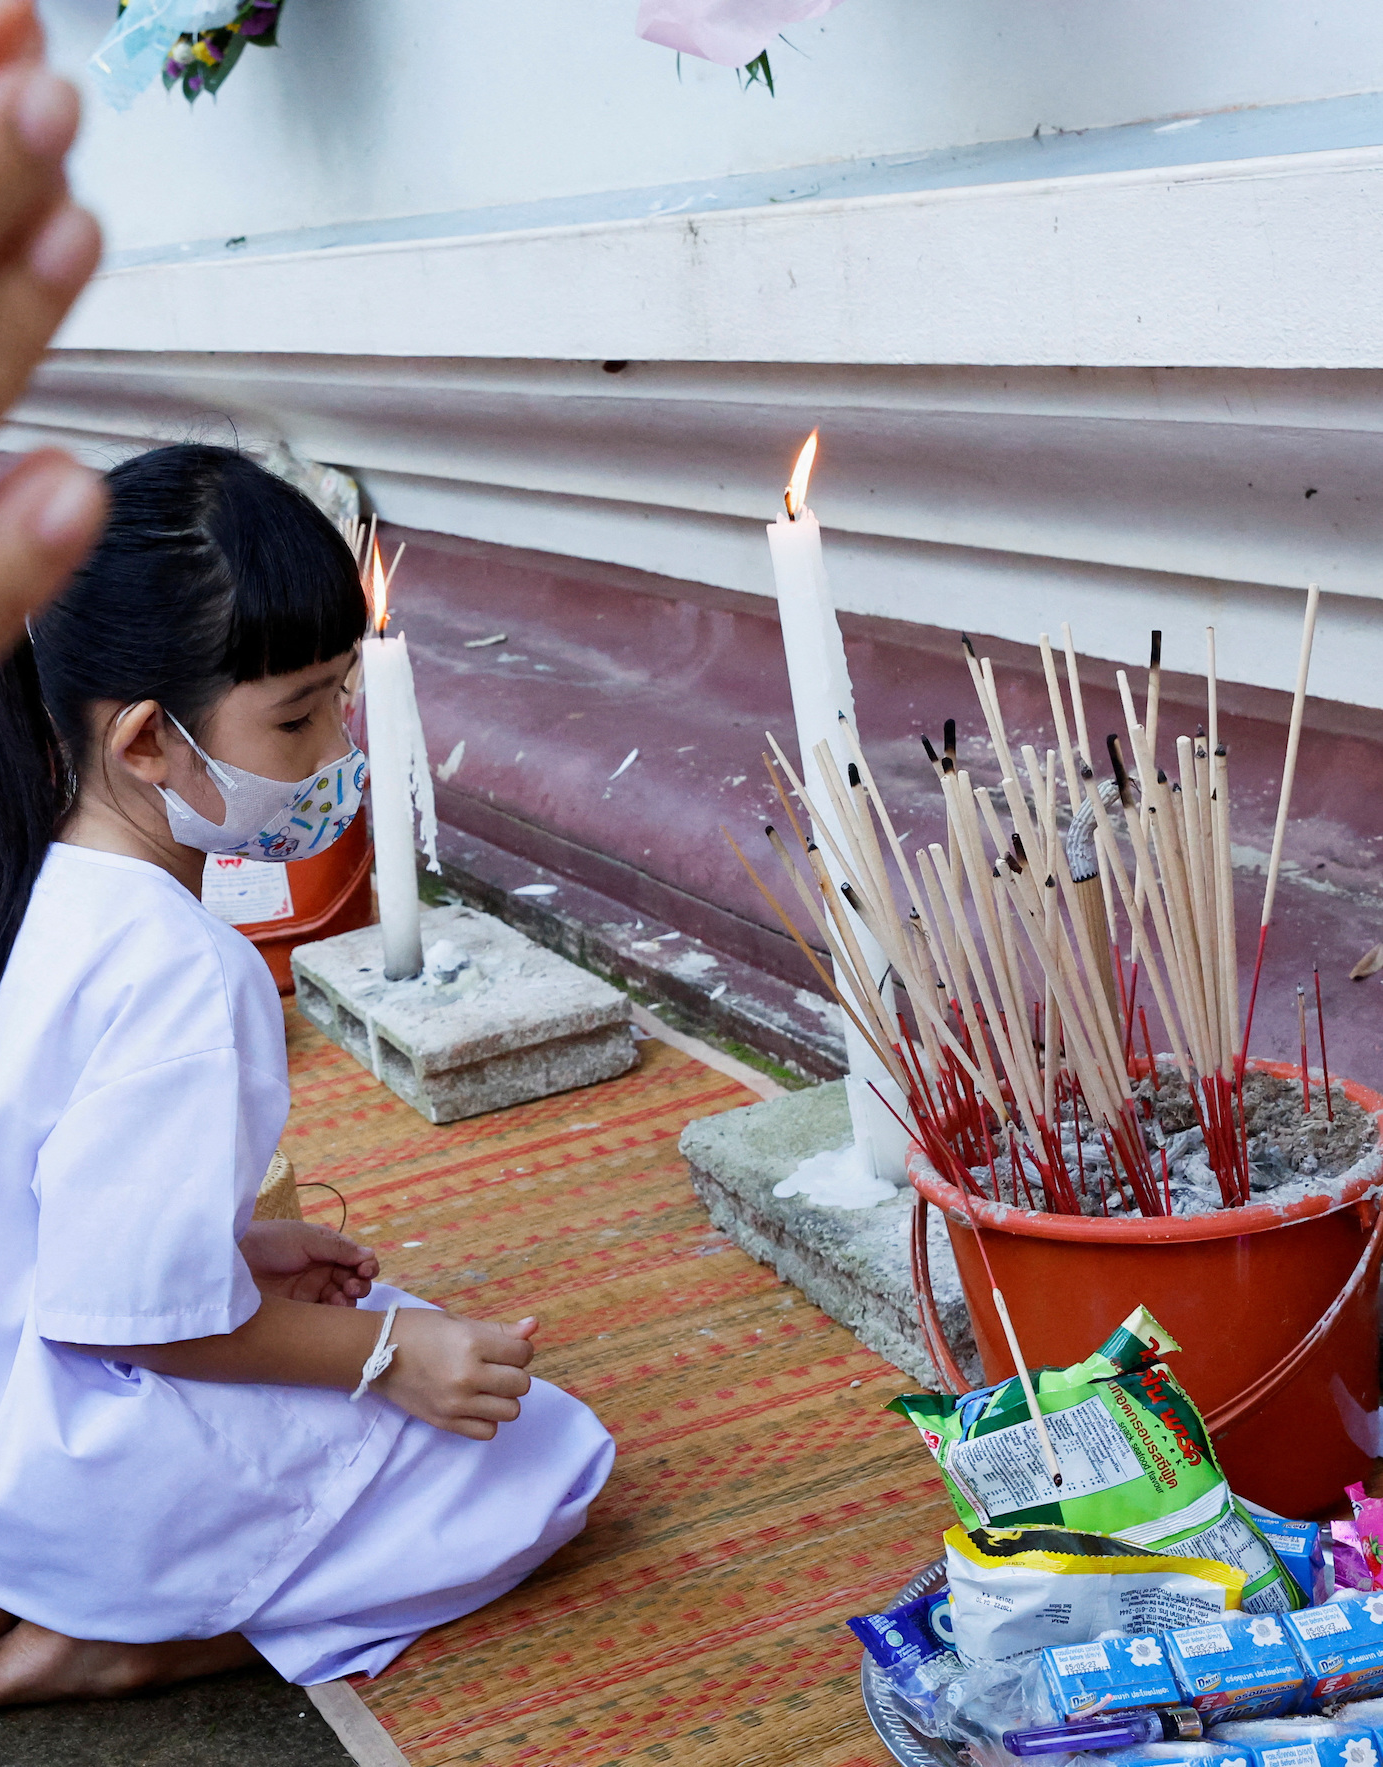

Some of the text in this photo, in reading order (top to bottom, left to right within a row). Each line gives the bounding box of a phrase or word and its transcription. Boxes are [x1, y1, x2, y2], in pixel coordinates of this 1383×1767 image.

[1119, 1421, 1164, 1495] snack seafood flavour
[1149, 1586, 1171, 1597] Product
[1306, 1623, 1336, 1635] 05/05/23
[1185, 1642, 1217, 1653] 05/05/23
[1065, 1660, 1097, 1671] 05/05/23
[1198, 1701, 1214, 1712] 5
